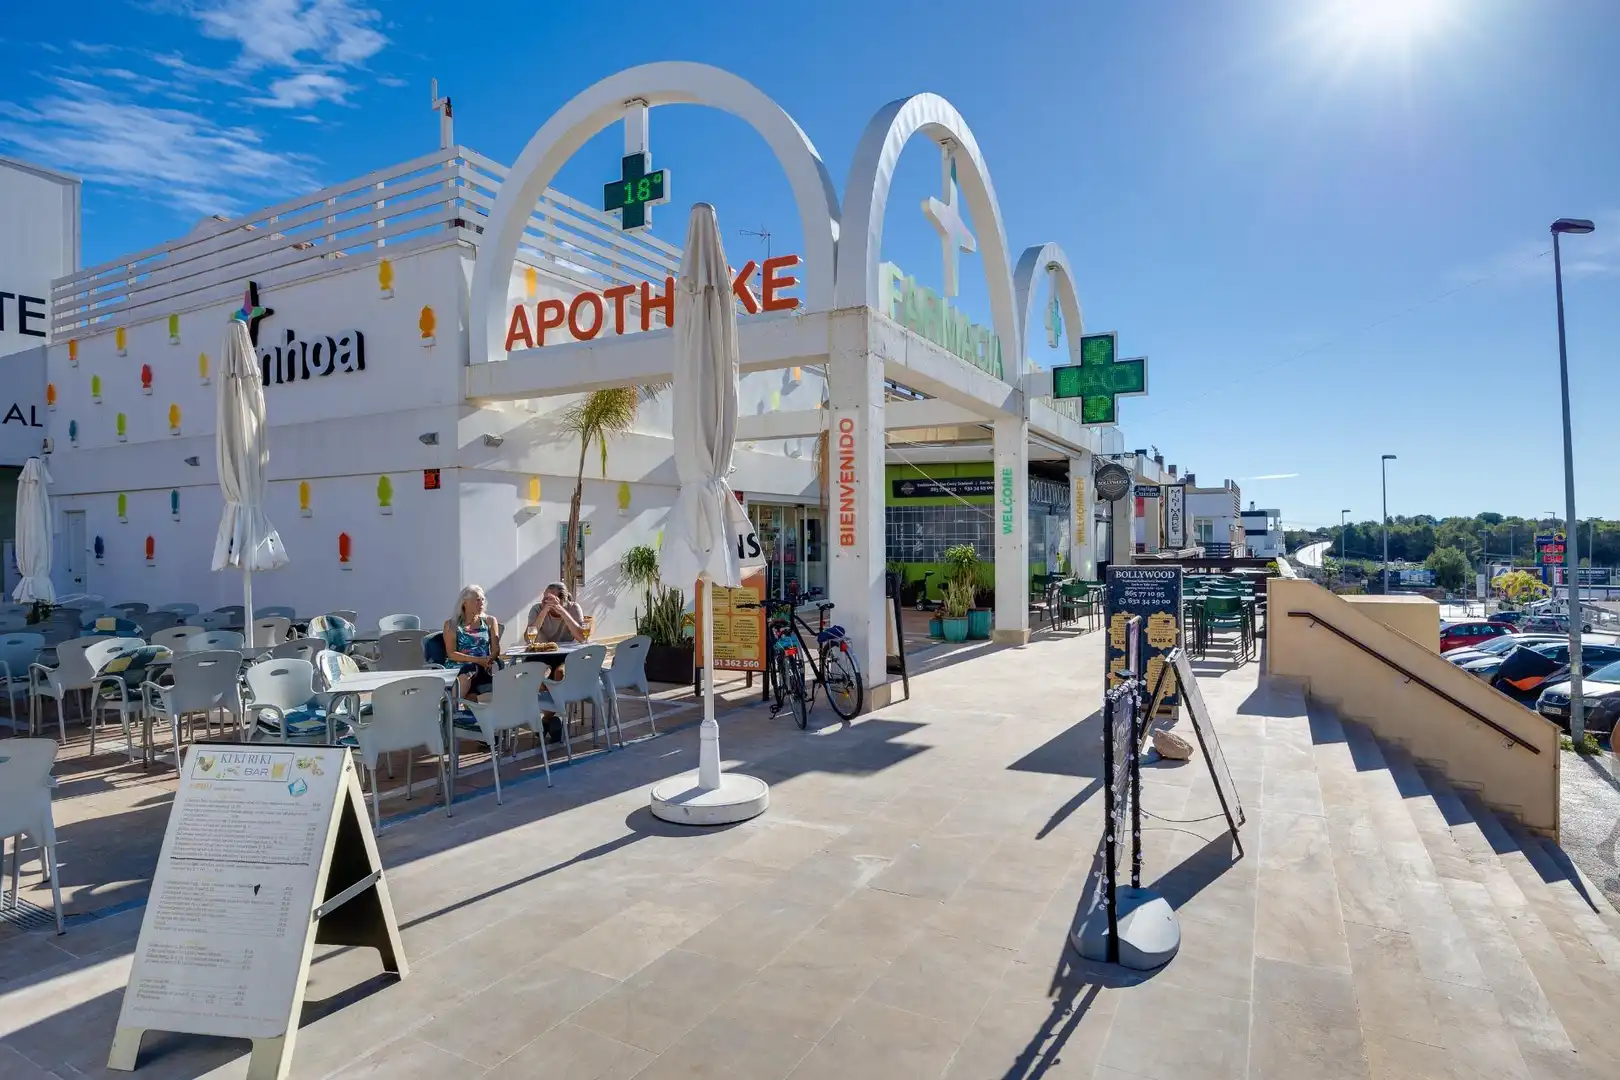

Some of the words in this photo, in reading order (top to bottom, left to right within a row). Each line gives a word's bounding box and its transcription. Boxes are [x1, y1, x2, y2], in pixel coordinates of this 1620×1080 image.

[505, 254, 800, 352] APOTHKE
[256, 329, 365, 386] nhoa
[2, 403, 43, 427] AL
[839, 418, 855, 547] BIENVENIDO
[1030, 480, 1070, 506] BOLLYWOO
[1002, 467, 1013, 535] WELCOME
[1170, 489, 1180, 506] MINI
[1115, 570, 1175, 579] BOLLYWOOD
[725, 659, 741, 667] 362
[244, 767, 269, 776] BAR
